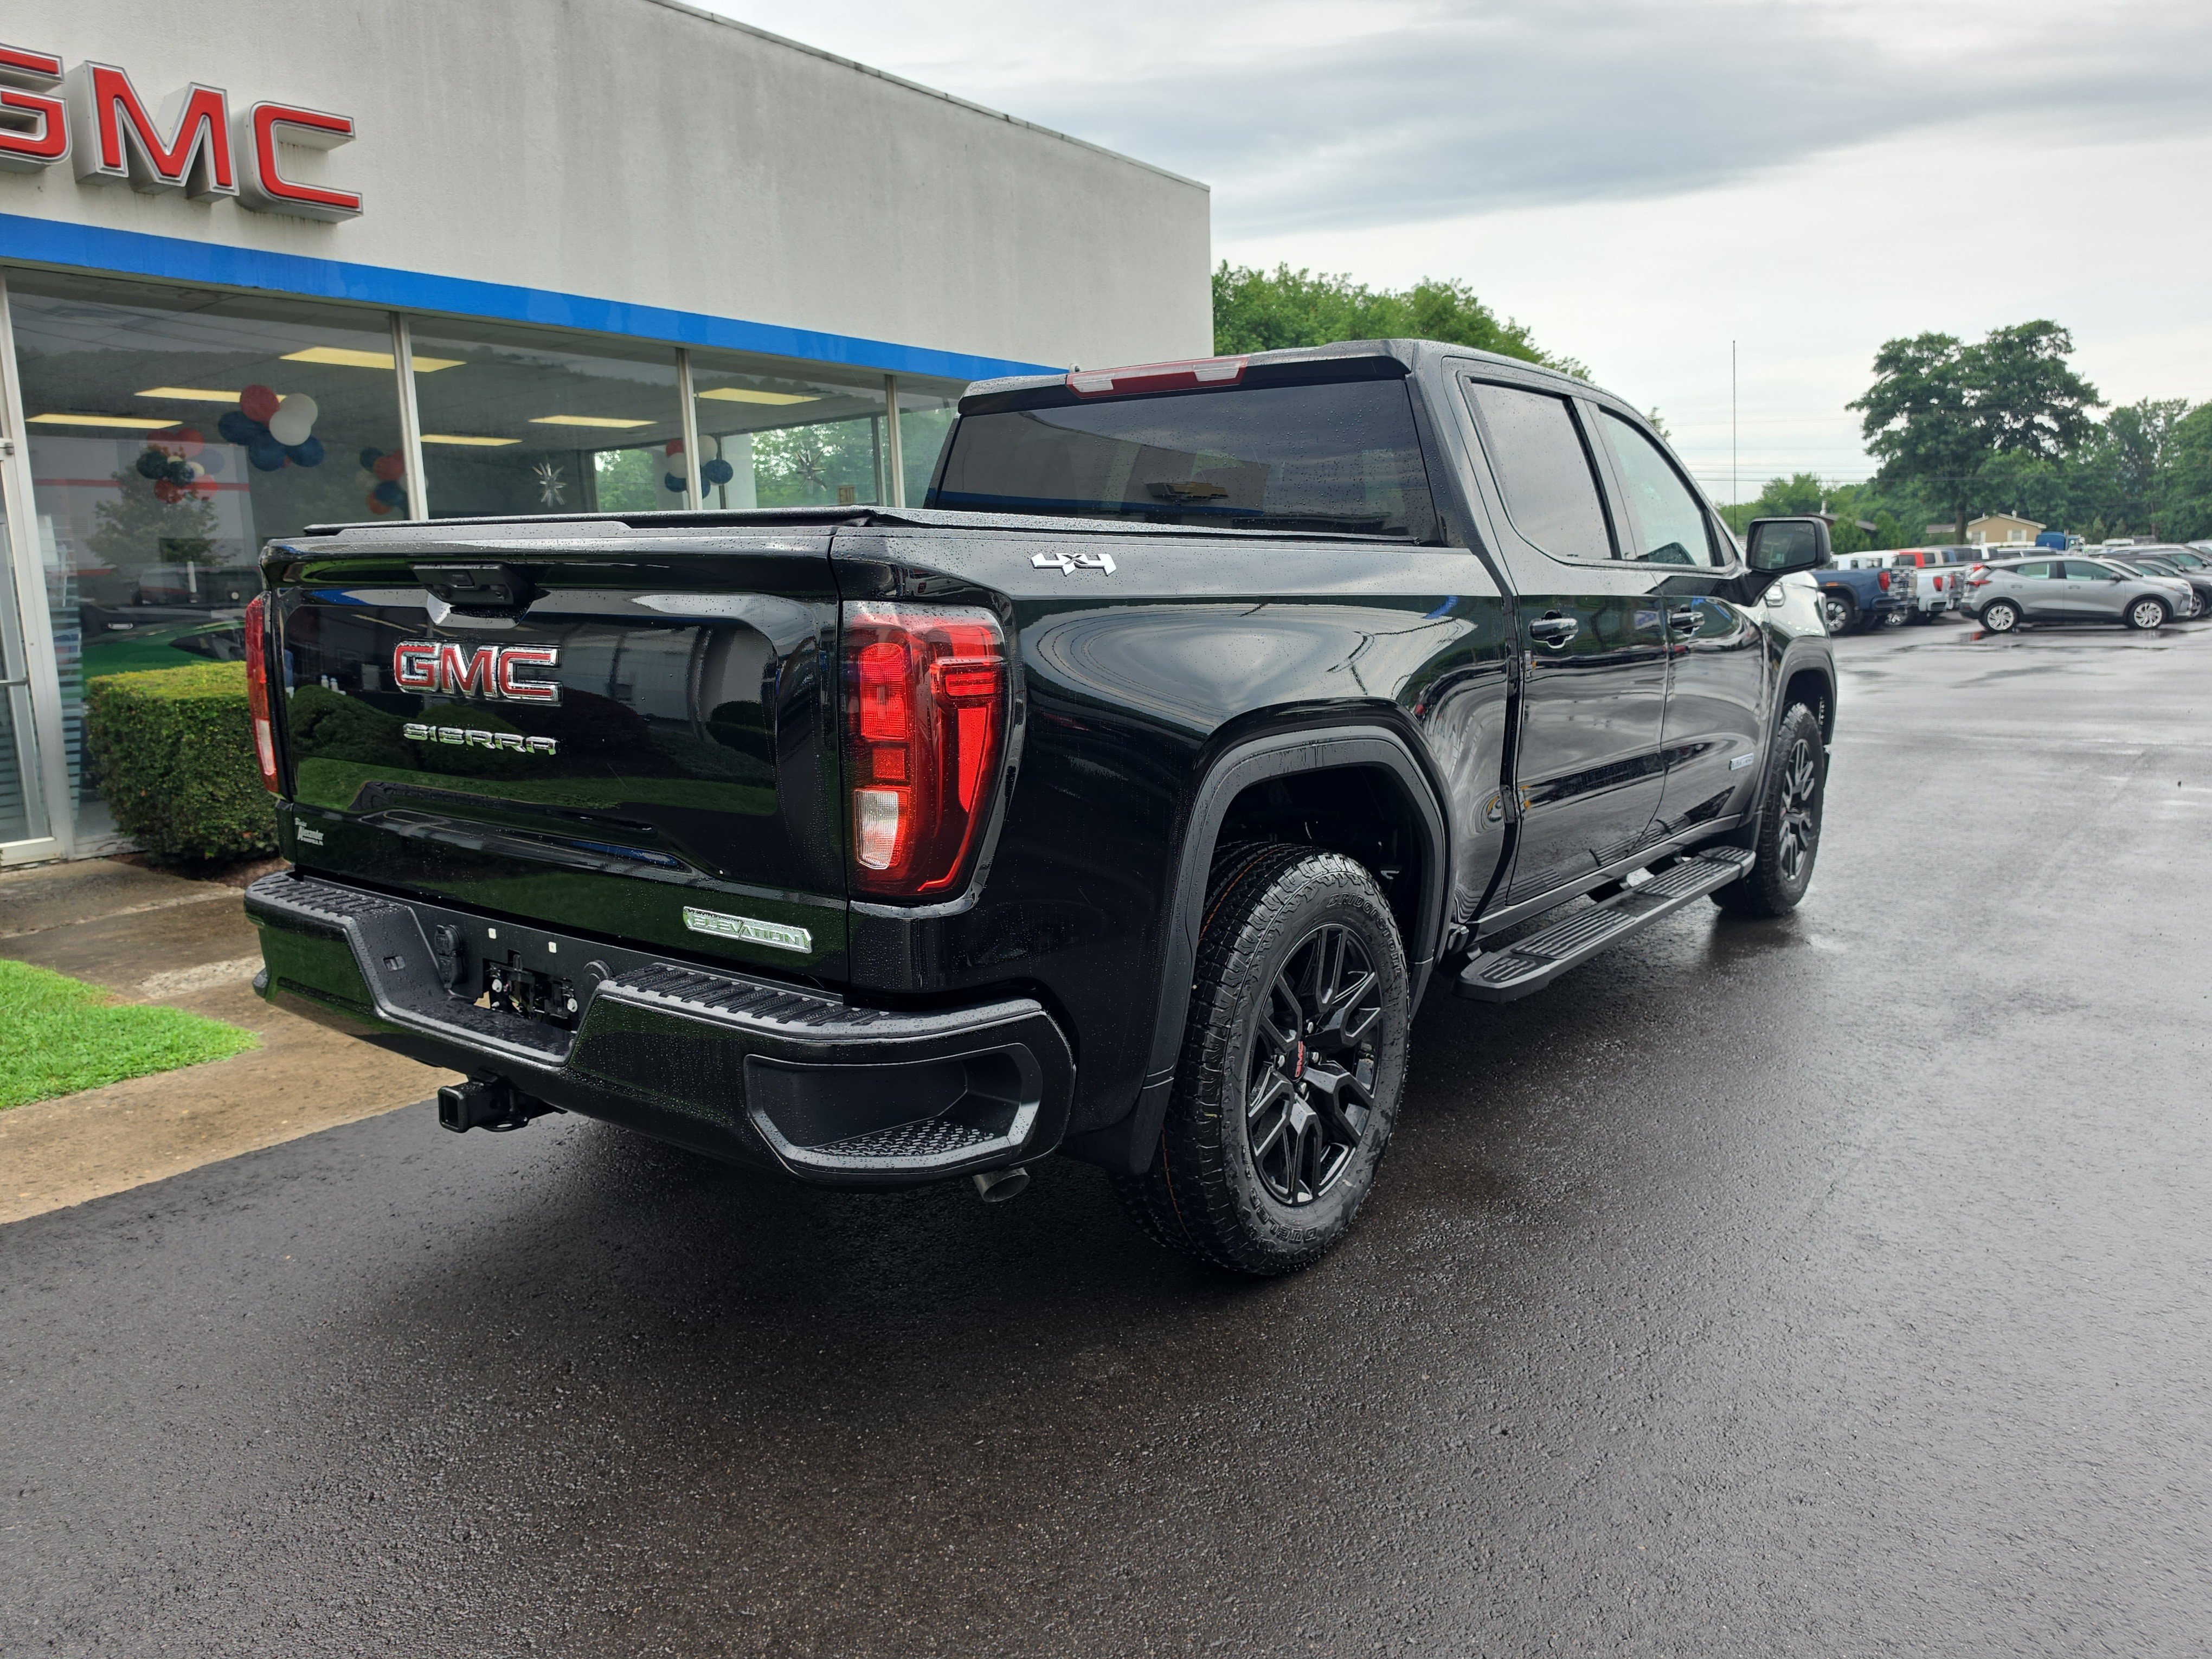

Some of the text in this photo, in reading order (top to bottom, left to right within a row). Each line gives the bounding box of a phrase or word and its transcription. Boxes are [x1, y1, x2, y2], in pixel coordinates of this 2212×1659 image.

[838, 487, 855, 503] EXIT
[394, 640, 561, 703] GMC
[403, 723, 559, 755] SIERRA
[691, 913, 802, 946] ELEVATION
[1326, 892, 1403, 978] BRIDGESTONE
[1295, 1041, 1303, 1077] GMC
[1250, 1186, 1319, 1244] DUELER
